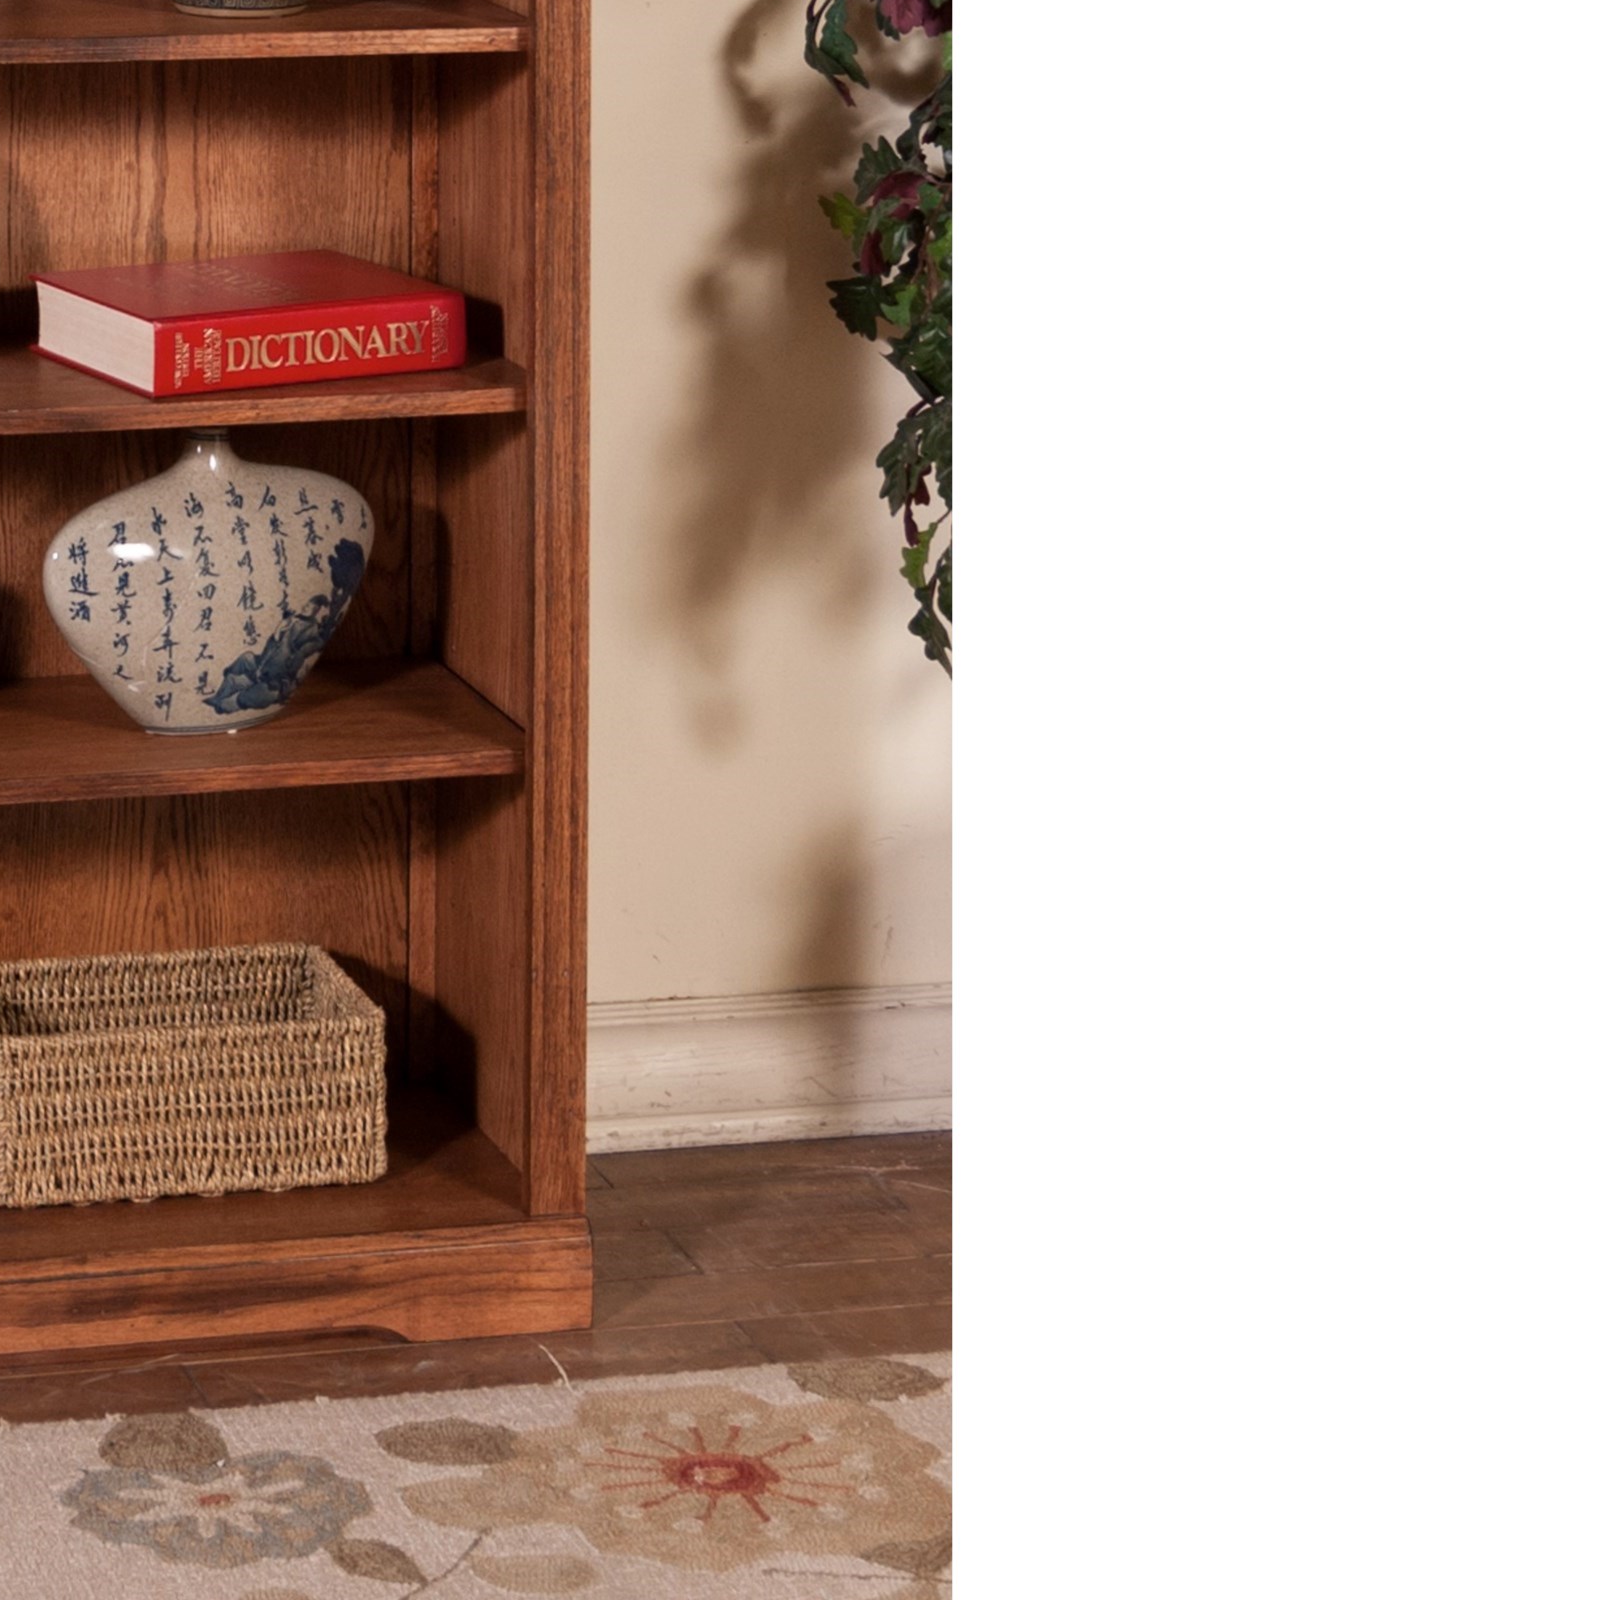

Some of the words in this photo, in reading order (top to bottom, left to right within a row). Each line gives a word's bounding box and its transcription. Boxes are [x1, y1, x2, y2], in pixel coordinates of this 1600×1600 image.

[193, 346, 203, 370] THE
[203, 328, 213, 385] AMERICAN
[225, 320, 430, 373] DICTIONARY
